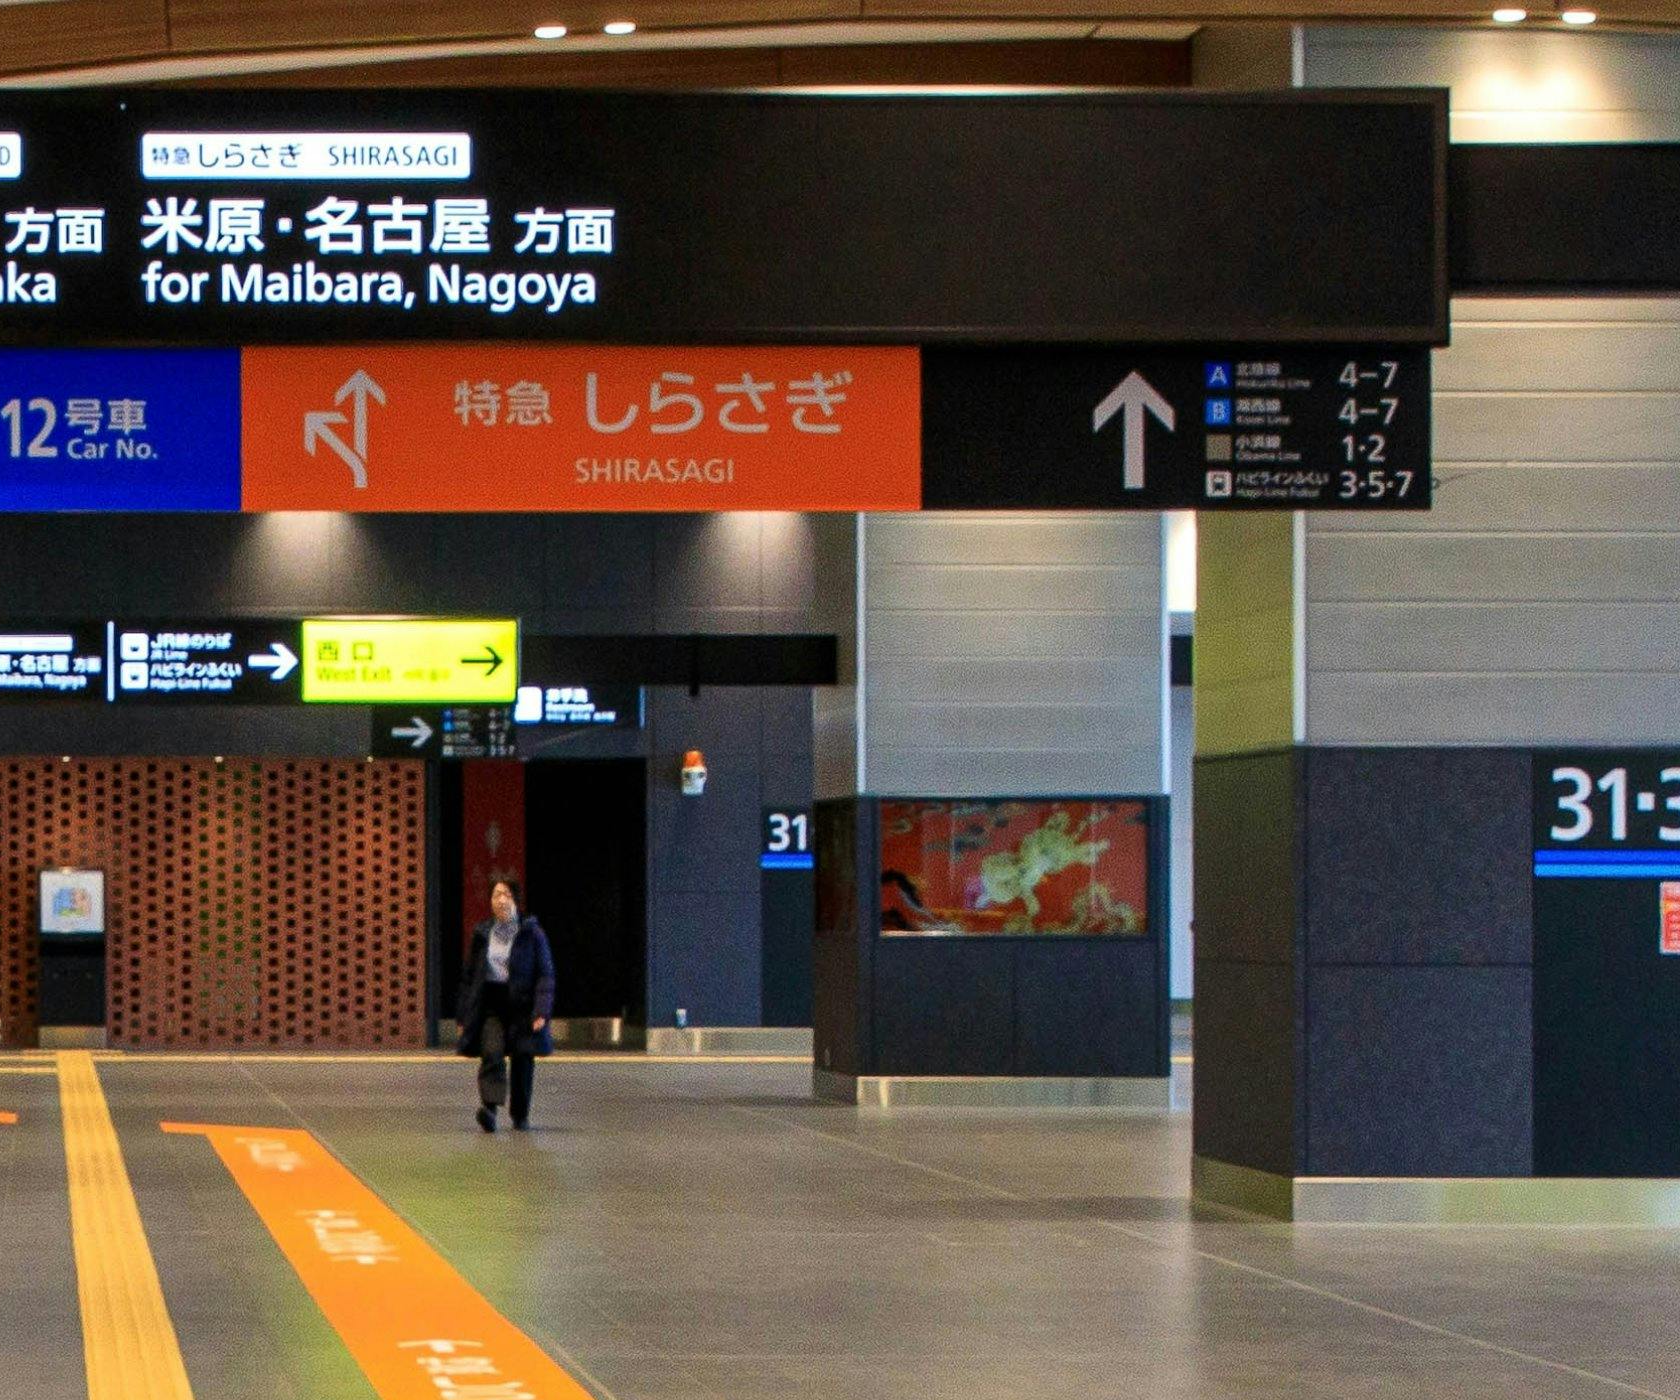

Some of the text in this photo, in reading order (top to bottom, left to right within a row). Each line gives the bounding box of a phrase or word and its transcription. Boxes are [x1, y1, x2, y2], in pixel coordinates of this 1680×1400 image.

[151, 143, 458, 168] 特急 しらさぎ SHIRASAGI
[4, 207, 105, 253] 方面
[140, 196, 615, 253] 米原・名古屋 方面
[141, 261, 596, 313] for Maibara, Nagoya
[64, 398, 147, 436] 号車
[454, 371, 853, 435] 特急 しらさぎ
[67, 438, 159, 459] Car No.
[575, 457, 735, 484] SHIRASAGI
